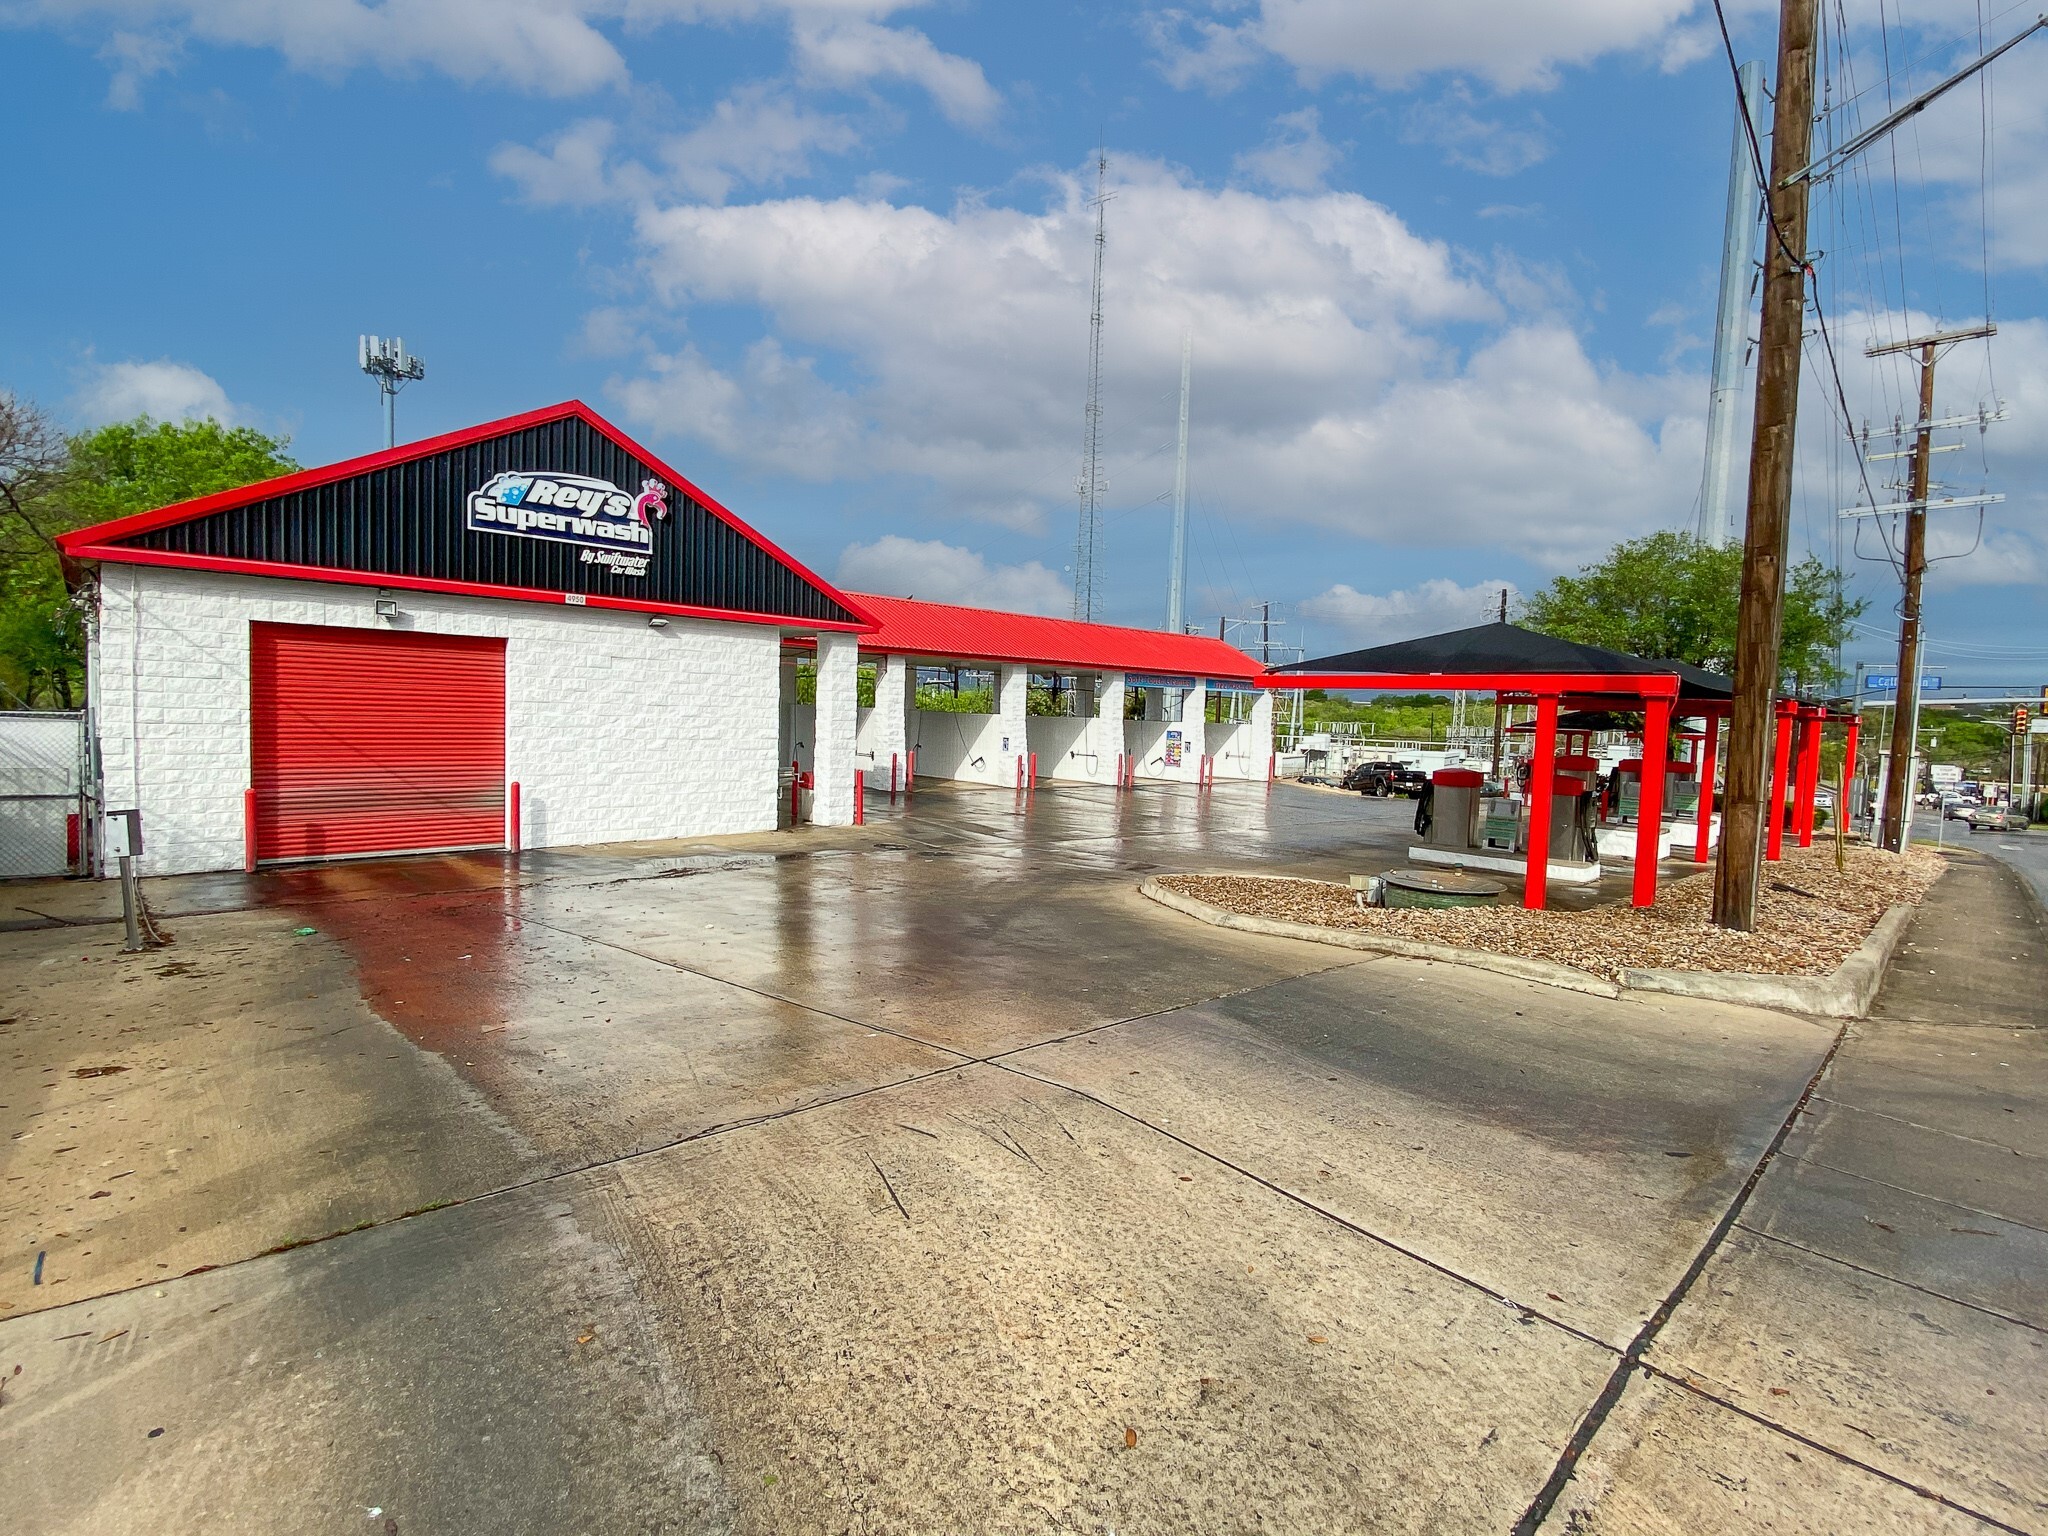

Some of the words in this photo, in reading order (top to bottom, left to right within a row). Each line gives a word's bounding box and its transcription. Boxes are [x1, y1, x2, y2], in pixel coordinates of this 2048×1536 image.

[526, 480, 631, 518] Rey's
[475, 498, 649, 544] Superwash
[580, 550, 595, 564] By
[594, 551, 650, 568] Swiftwater
[611, 565, 625, 574] Car
[624, 566, 646, 576] Wash
[567, 595, 584, 603] 4950
